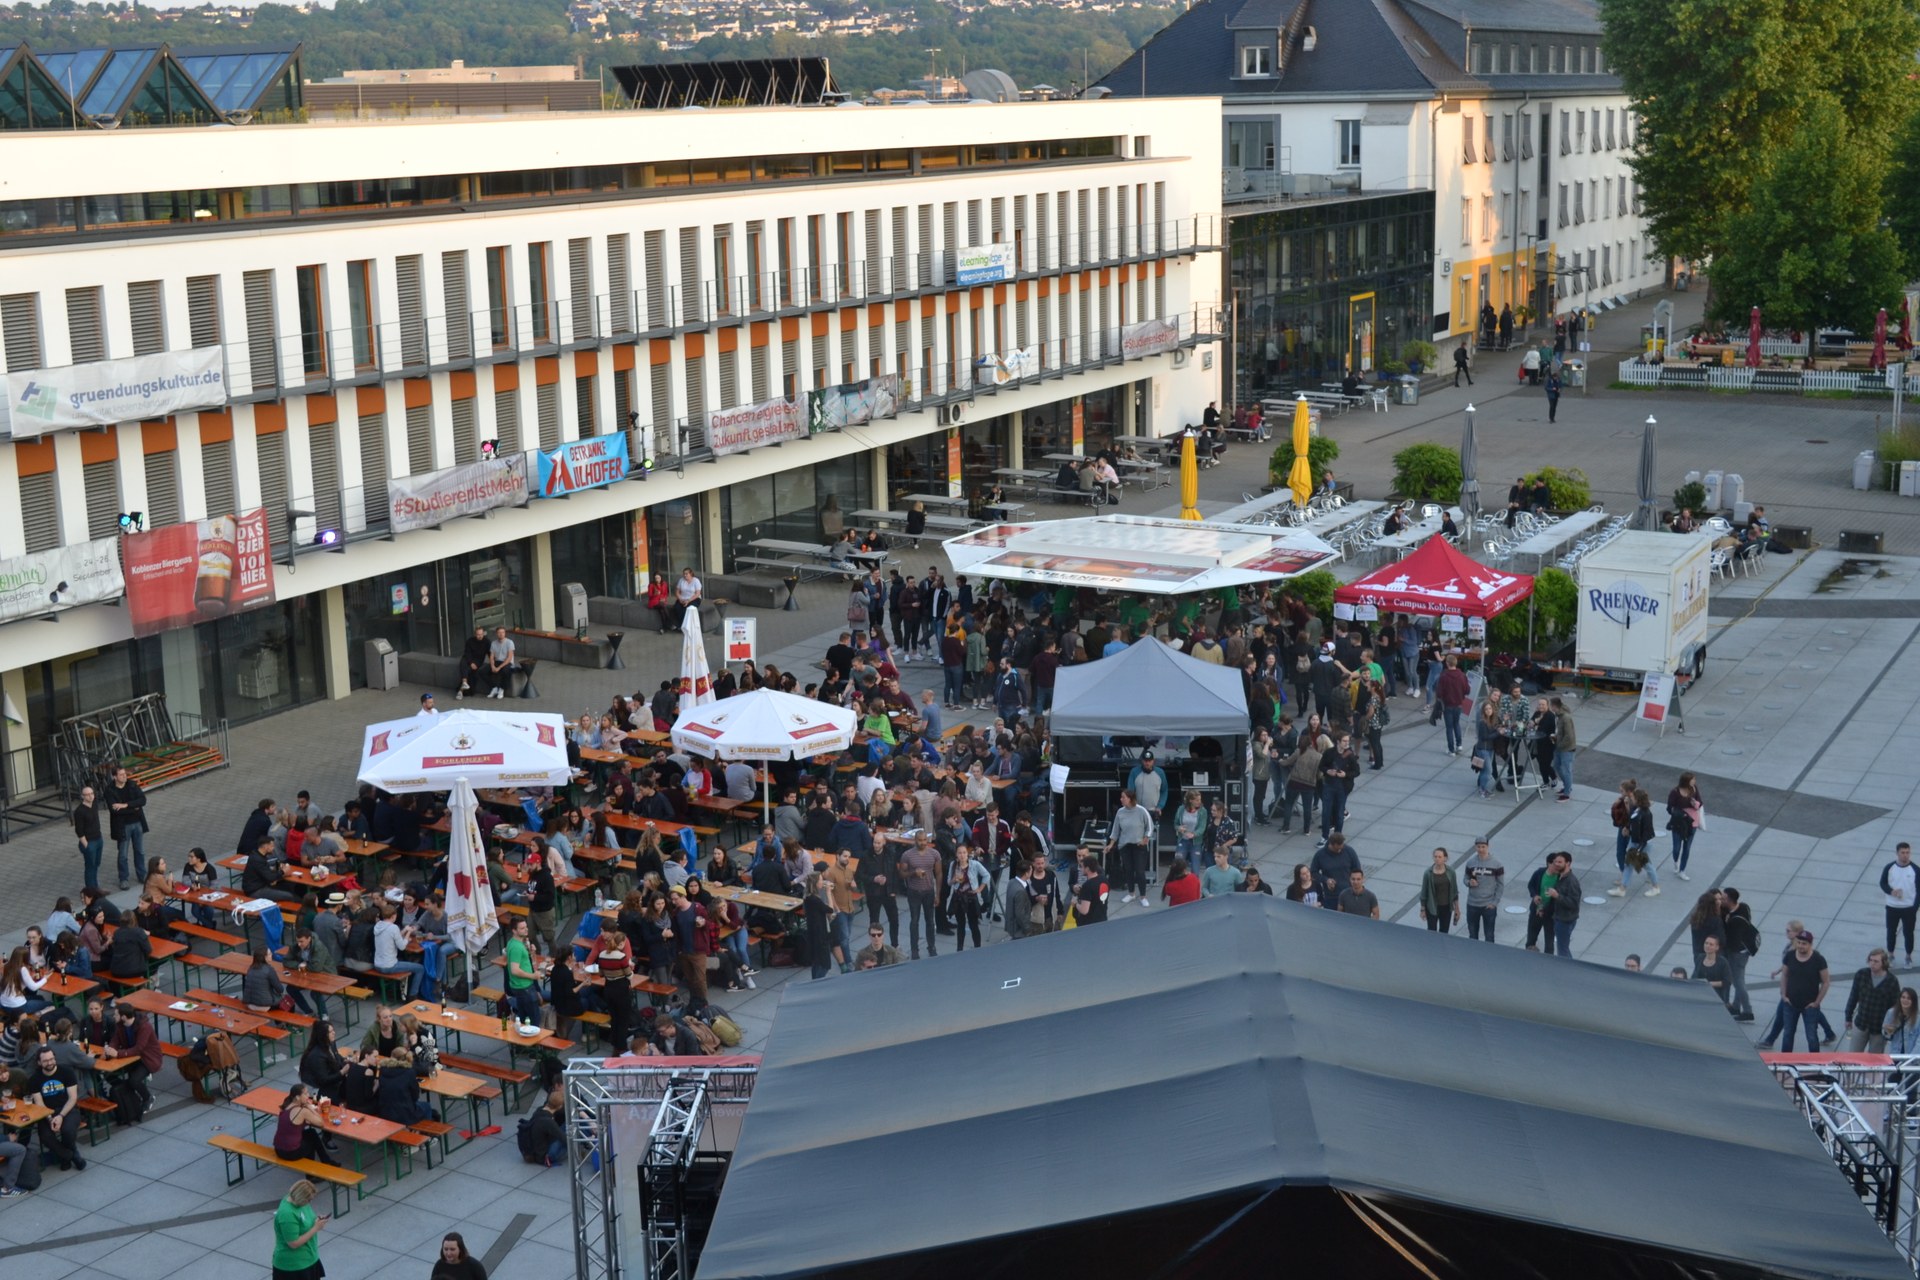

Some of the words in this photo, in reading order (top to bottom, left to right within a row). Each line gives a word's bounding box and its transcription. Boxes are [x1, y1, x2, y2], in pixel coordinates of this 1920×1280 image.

[1443, 261, 1451, 273] B
[1174, 350, 1185, 365] D
[70, 370, 221, 409] gruendungskultur.de
[712, 410, 755, 429] Chancen
[713, 427, 752, 448] Zukunft
[394, 475, 525, 516] #StudierenIstMehr
[237, 522, 264, 540] DAS
[237, 537, 265, 555] BIER
[131, 562, 162, 575] Koblenzer
[239, 553, 266, 571] VON
[241, 567, 267, 586] HIER
[1358, 594, 1387, 607] AStA
[1393, 598, 1428, 611] Campus
[1428, 603, 1461, 614] Koblenz
[1589, 589, 1659, 620] RHENSER
[434, 756, 491, 765] KOBLENZER
